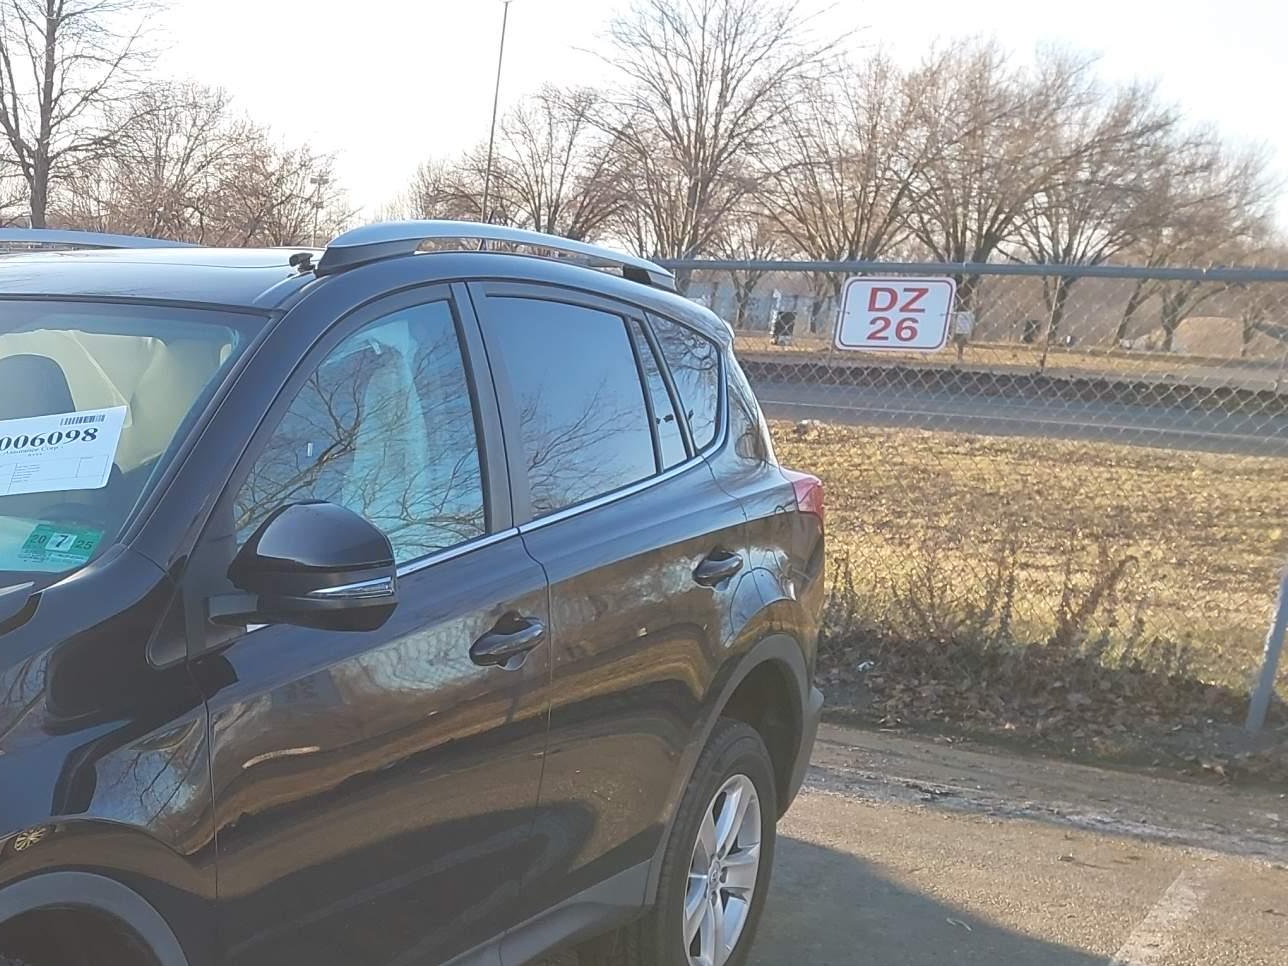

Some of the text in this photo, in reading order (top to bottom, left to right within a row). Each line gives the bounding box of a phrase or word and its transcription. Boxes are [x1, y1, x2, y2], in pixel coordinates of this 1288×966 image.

[867, 287, 929, 313] DZ
[866, 316, 919, 342] 26
[31, 534, 93, 550] 20 7 25
